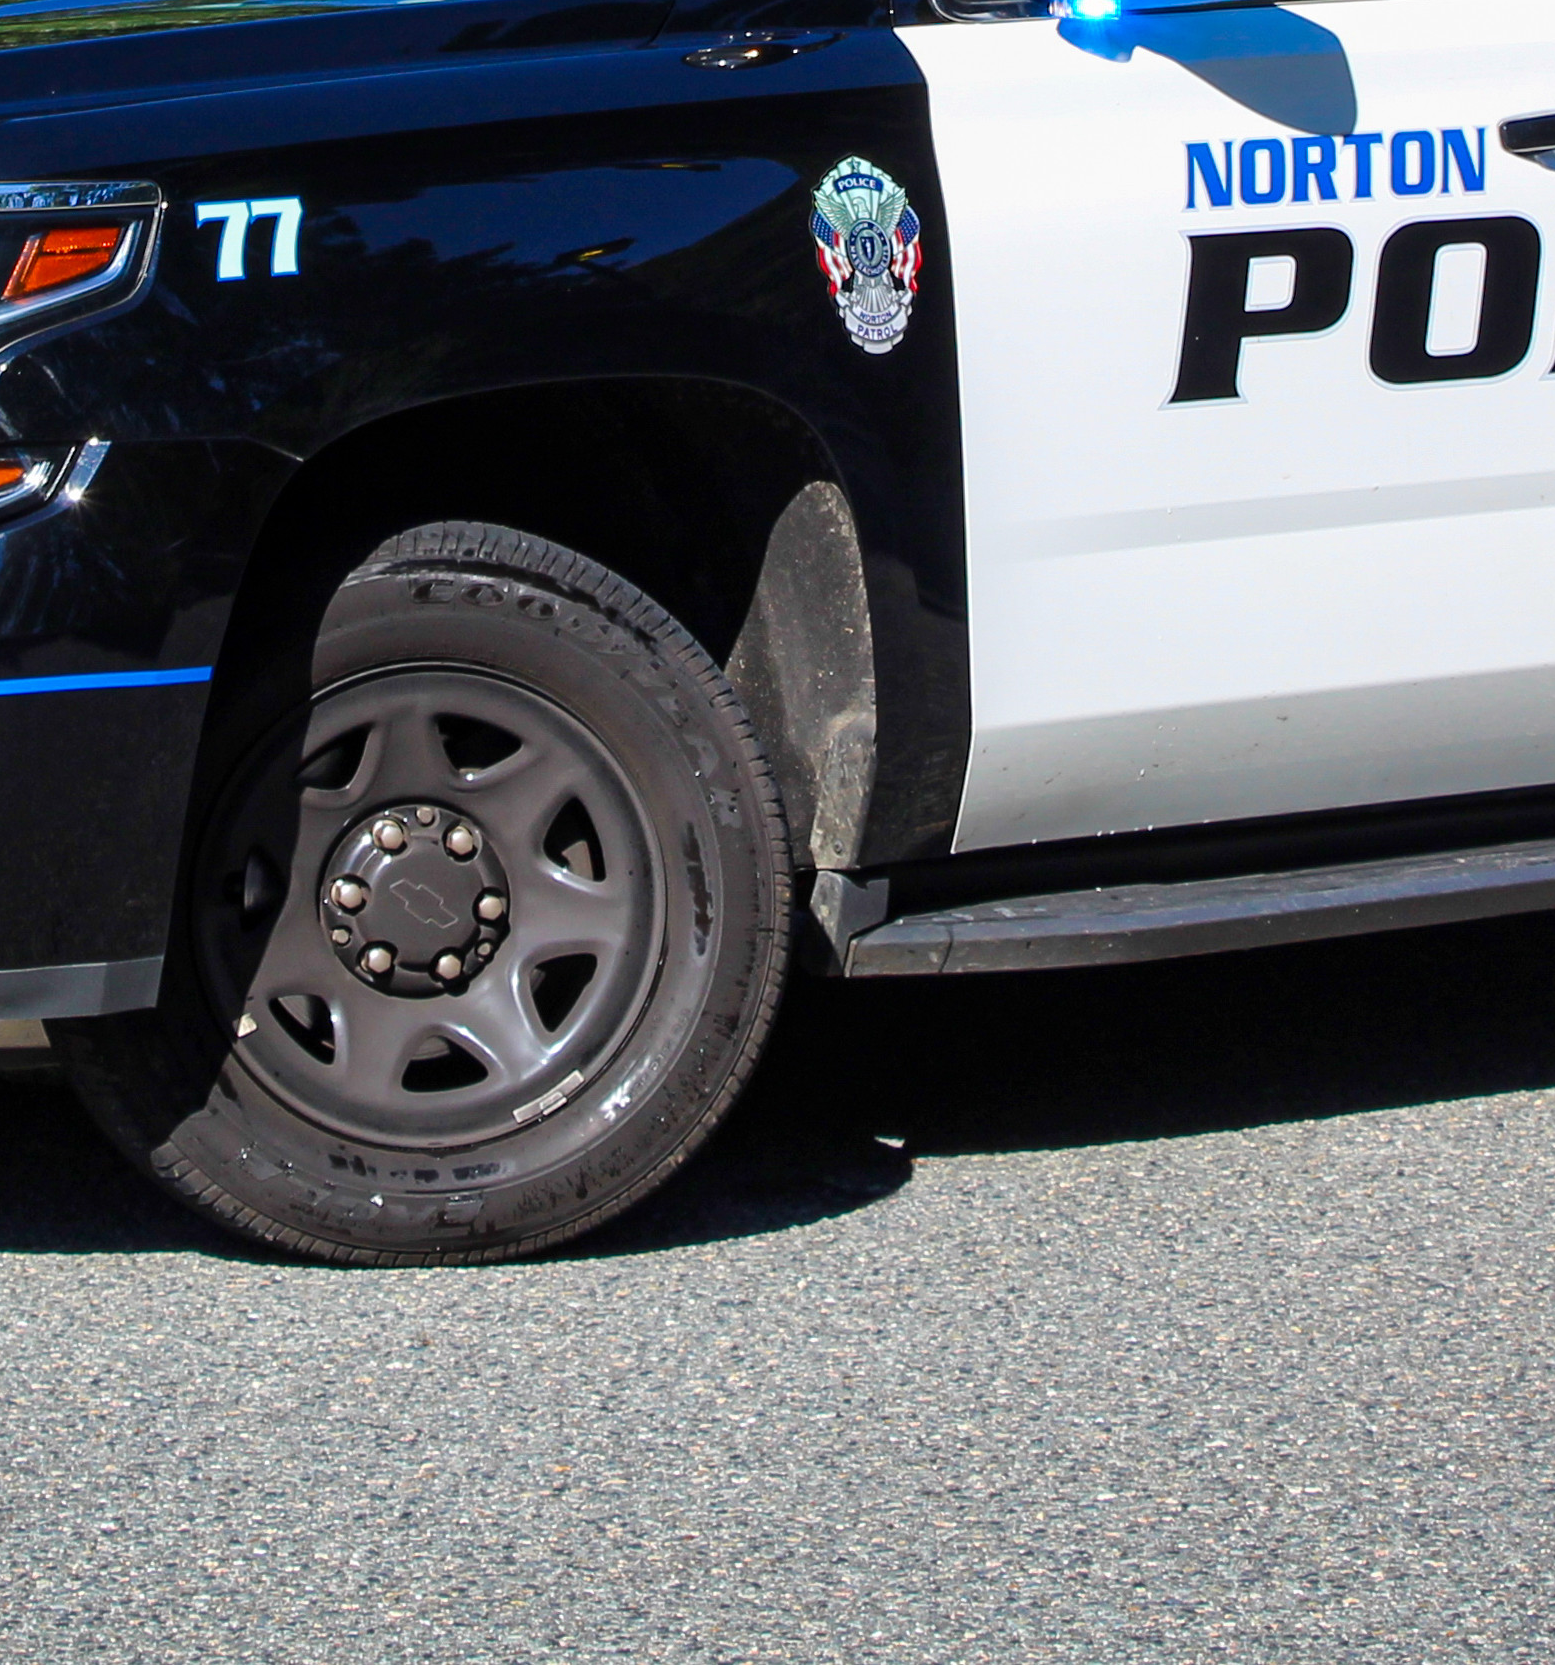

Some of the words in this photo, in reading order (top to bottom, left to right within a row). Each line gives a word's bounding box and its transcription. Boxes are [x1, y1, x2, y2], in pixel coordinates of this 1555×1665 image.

[1184, 126, 1488, 210] NORTON
[837, 177, 877, 191] POLICE
[195, 195, 303, 282] 77
[859, 310, 893, 324] NORTON
[857, 324, 898, 340] PATROL
